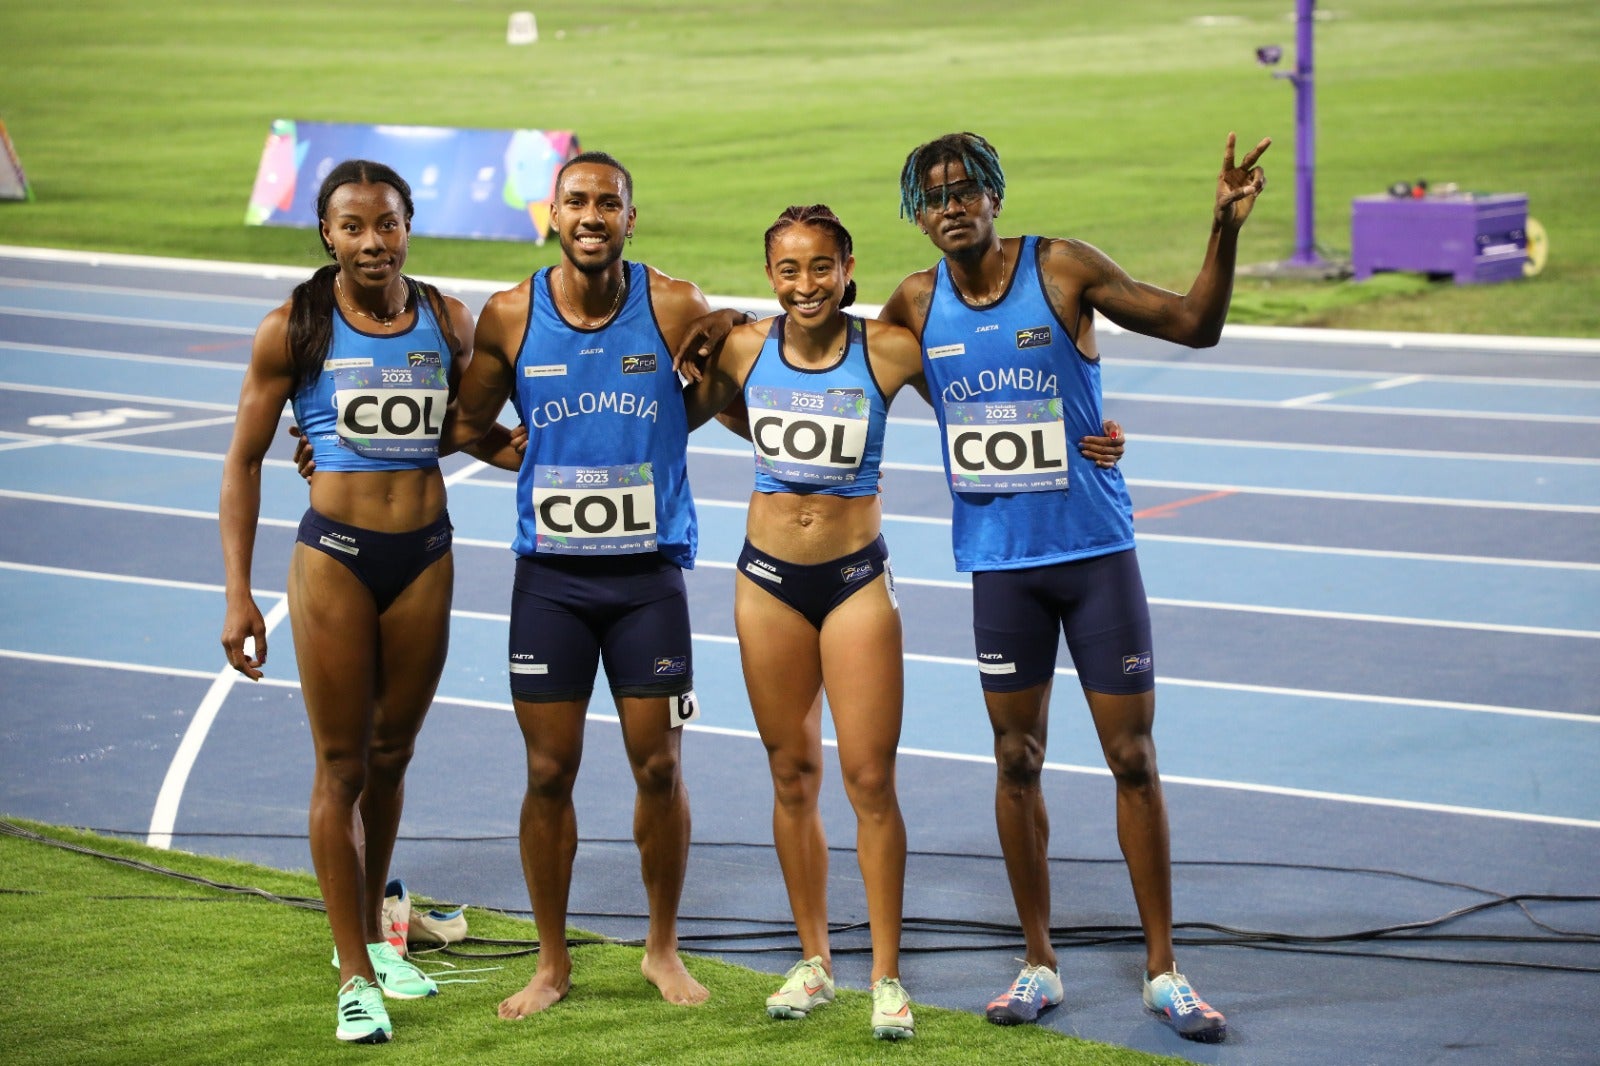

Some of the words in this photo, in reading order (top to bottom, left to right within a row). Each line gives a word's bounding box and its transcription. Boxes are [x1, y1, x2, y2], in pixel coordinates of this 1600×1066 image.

[975, 324, 999, 333] SAETA
[1033, 331, 1050, 341] FCA
[579, 347, 604, 355] SAETA
[639, 359, 655, 367] FCA
[382, 373, 413, 383] 2023
[942, 368, 1058, 404] COLOMBIA
[791, 396, 825, 409] 2023
[344, 395, 439, 435] COL
[531, 391, 658, 429] COLOMBIA
[985, 408, 1017, 419] 2023
[754, 416, 857, 464] COL
[954, 430, 1062, 471] COL
[575, 473, 609, 484] 2023
[540, 494, 651, 533] COL
[753, 559, 777, 572] SAETA
